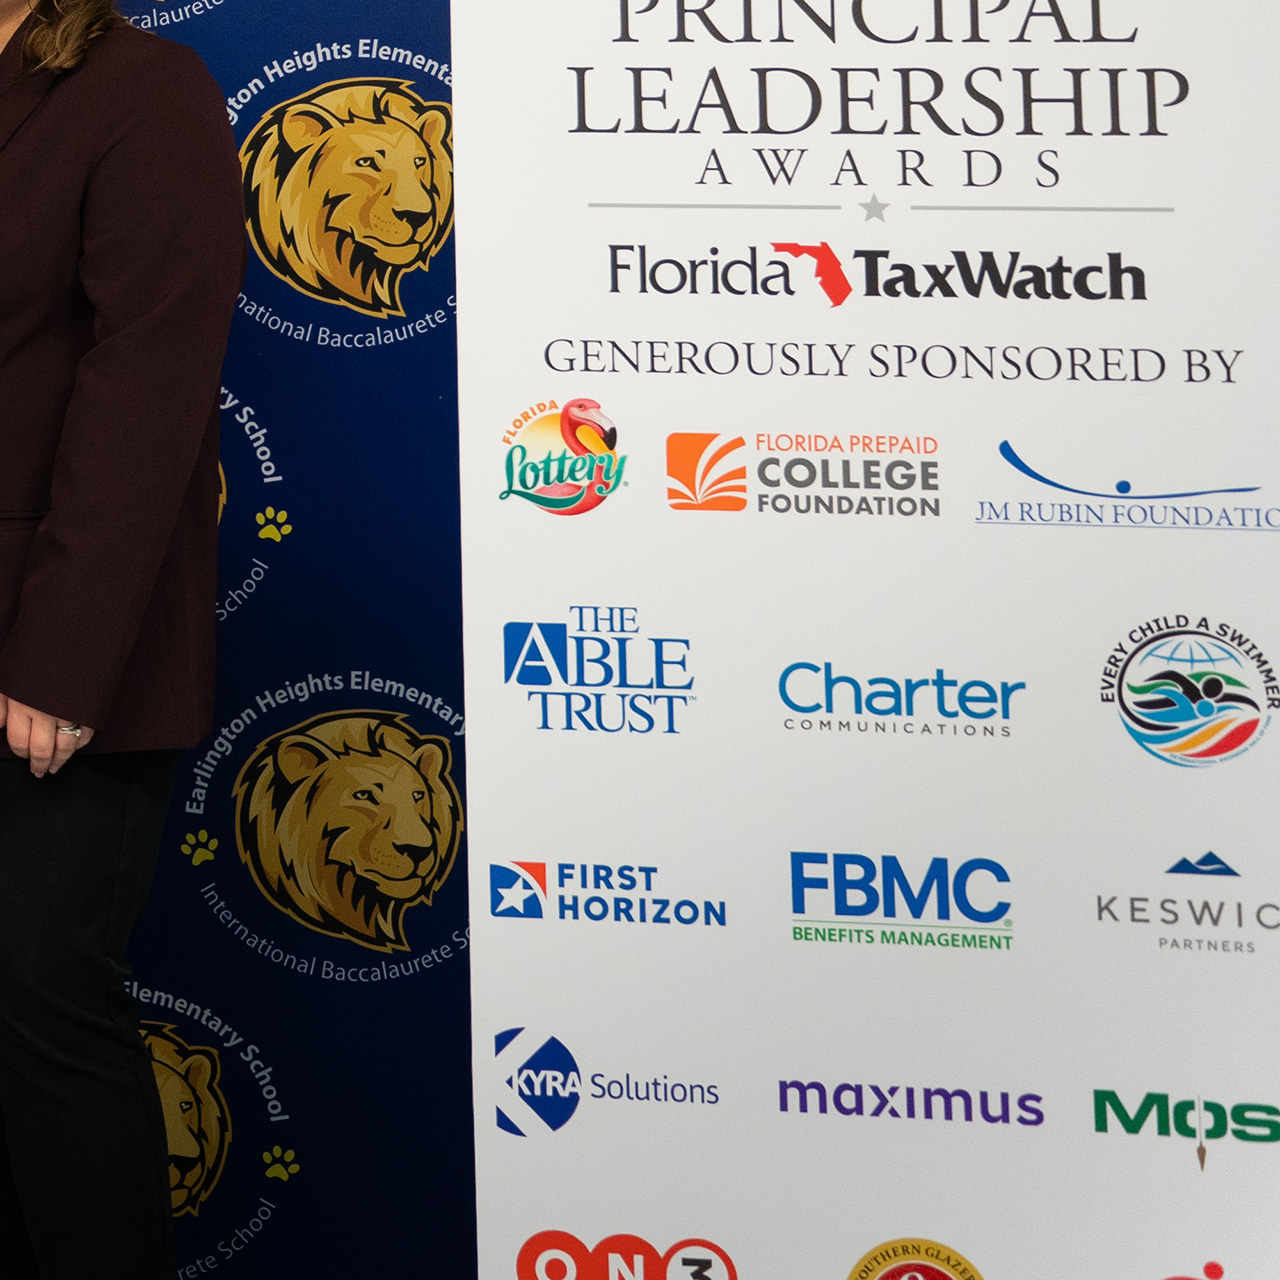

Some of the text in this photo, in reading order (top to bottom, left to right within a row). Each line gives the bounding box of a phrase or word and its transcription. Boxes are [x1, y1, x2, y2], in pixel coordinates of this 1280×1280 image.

[262, 38, 453, 88] Heights Elementa
[566, 65, 1191, 137] LEADERSHIP
[694, 147, 1061, 189] AWARDS
[607, 244, 1148, 301] Florida TaxWatch
[236, 291, 448, 348] national Baccalaurete
[543, 338, 1245, 385] GENEROUSLY SPONSORED BY
[234, 405, 283, 484] School
[501, 399, 559, 445] FLORIDA
[755, 433, 939, 455] FLORIDA PREPAID
[498, 444, 628, 509] Lottery
[756, 456, 940, 492] COLLEGE
[756, 492, 941, 517] FOUNDATION
[974, 500, 1280, 528] JM RUBIN FOUNDATIO
[569, 605, 640, 634] THE
[510, 624, 694, 691] ABLE
[1100, 614, 1280, 710] EVERY CHILD A SWIMMER
[527, 690, 689, 735] TRUST
[777, 661, 1026, 720] Charter
[185, 706, 258, 815] Earlington
[254, 673, 345, 714] Heights
[783, 718, 1012, 738] COMMUNICATIONS
[557, 862, 658, 892] FIRST
[788, 850, 1012, 923] FBMC
[200, 882, 454, 983] International Baccalaurete
[557, 895, 727, 927] HORIZON
[1096, 895, 1280, 931] KESWIC
[791, 926, 1014, 951] BENEFITS MANAGEMENT
[1158, 937, 1256, 955] PARTNERS
[239, 1044, 290, 1123] School
[512, 1069, 720, 1105] KYRA Solutions
[777, 1078, 1045, 1127] maximus
[216, 1197, 277, 1261] School
[856, 1244, 921, 1280] OUTHERN
